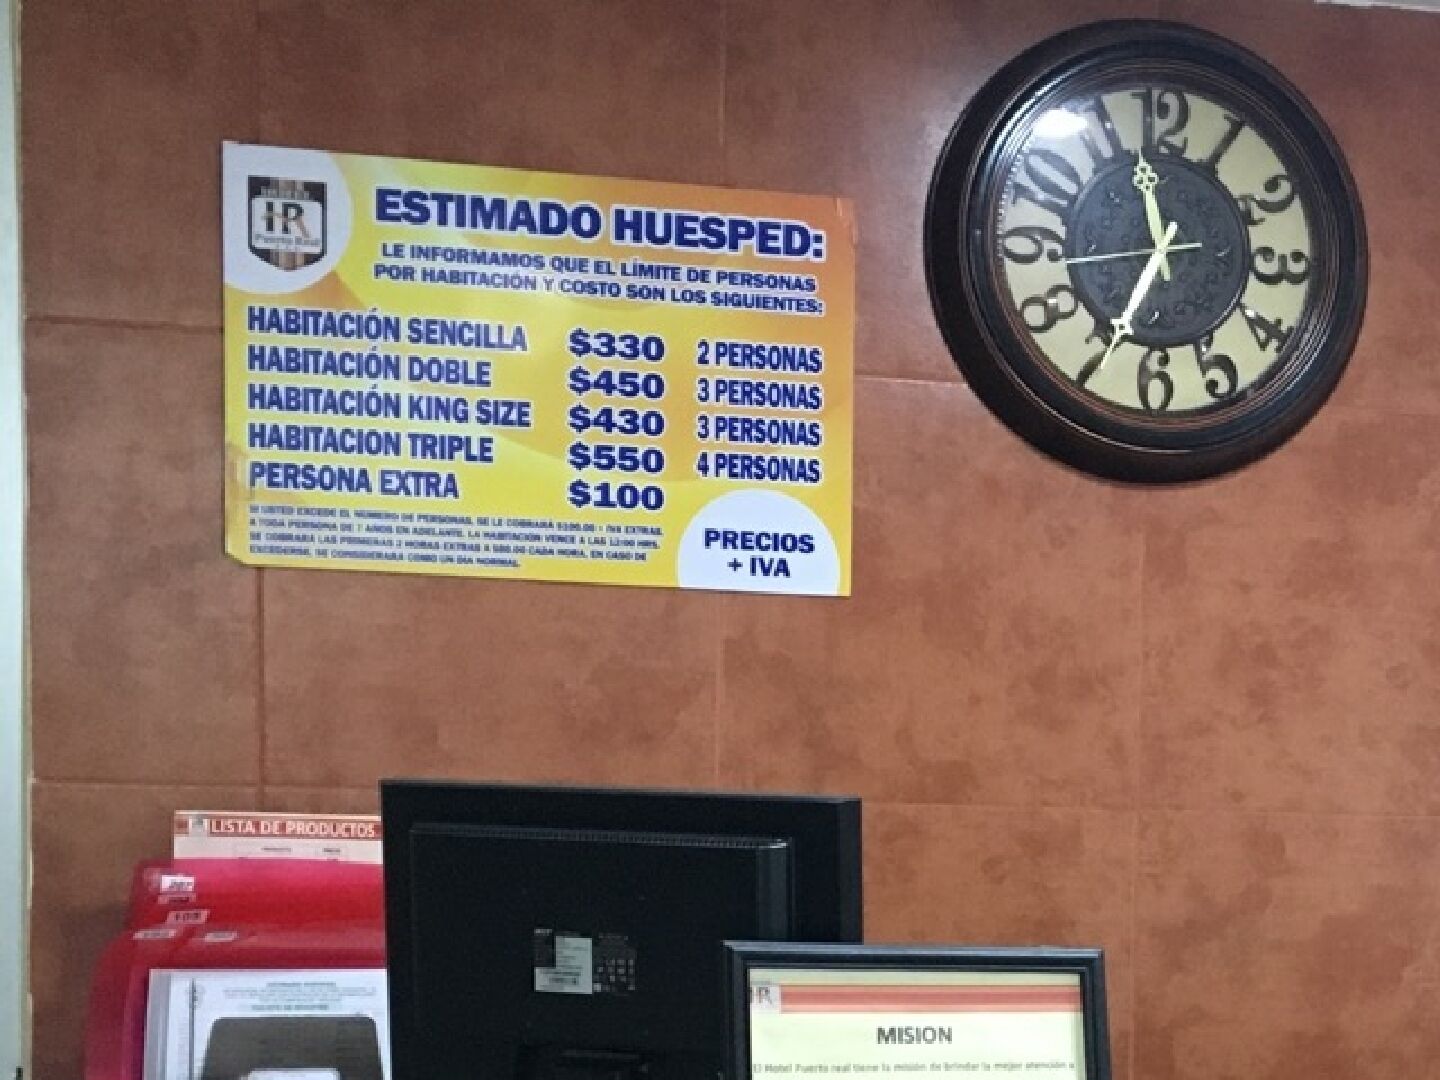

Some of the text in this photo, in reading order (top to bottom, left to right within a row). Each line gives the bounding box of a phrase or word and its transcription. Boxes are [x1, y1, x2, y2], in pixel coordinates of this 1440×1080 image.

[1131, 87, 1190, 155] 12
[1197, 114, 1247, 167] 1
[1010, 148, 1085, 216] 10
[1237, 174, 1296, 226] 2
[375, 188, 823, 258] ESTIMADO HUESPED:
[1001, 224, 1068, 264] 9
[382, 243, 405, 258] LE
[410, 245, 545, 270] INFORMAMOS
[552, 256, 589, 273] QUE
[594, 260, 615, 274] EL
[687, 267, 710, 283] DE
[717, 271, 816, 292] PERSONAS
[1250, 246, 1311, 285] 3
[374, 264, 414, 280] POR
[544, 278, 554, 290] Y
[560, 280, 621, 295] COSTO
[627, 284, 664, 300] SON
[671, 288, 707, 303] LOS
[711, 291, 822, 315] SIGUIENTES:
[248, 306, 528, 351] HABITACIÓN SENCILLA
[1021, 285, 1078, 334] 8
[1238, 302, 1294, 352] 4
[569, 328, 665, 362] $330
[697, 340, 822, 373] 2 PERSONAS
[1195, 328, 1238, 400] 5
[248, 344, 491, 387] HABITACIÓN DOBLE
[569, 366, 665, 399] $450
[1137, 346, 1174, 412] 6
[248, 383, 531, 427] HABITACIÓN KING SIZE
[698, 378, 822, 410] 3 PERSONAS
[569, 403, 665, 436] $430
[698, 415, 822, 447] 3 PERSONAS
[408, 433, 493, 463] TRIPLE
[569, 441, 665, 473] $550
[697, 452, 822, 483] 4 PERSONAS
[250, 461, 459, 498] PERSONA EXTRA
[569, 479, 665, 510] $100
[704, 528, 815, 553] PRECIOS
[727, 557, 791, 577] + IVA
[210, 820, 375, 838] LISTA DE PRODUCTOS
[876, 1026, 952, 1044] MISION
